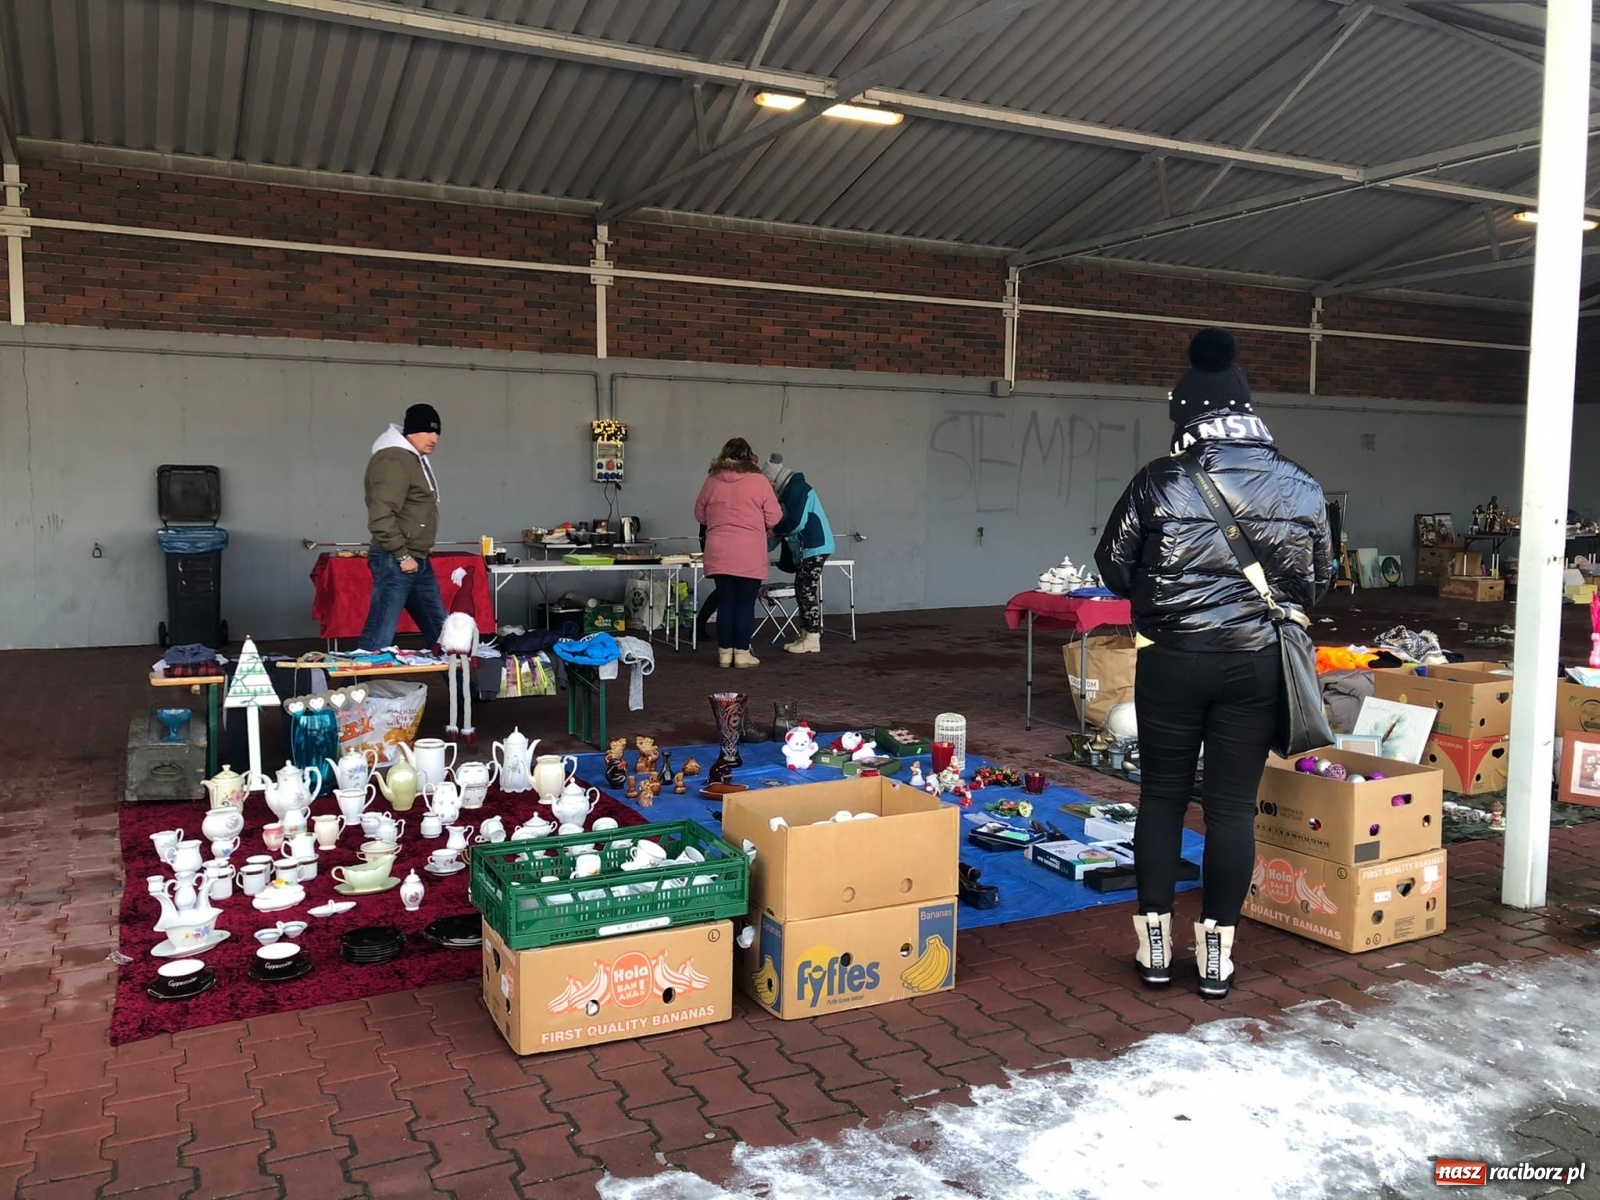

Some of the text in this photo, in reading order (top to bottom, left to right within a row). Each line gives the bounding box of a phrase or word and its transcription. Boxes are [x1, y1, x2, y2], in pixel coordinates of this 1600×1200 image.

[1268, 868, 1292, 883] Hola
[1363, 869, 1383, 880] FIRST
[1384, 863, 1413, 876] QUALITY
[920, 909, 953, 921] Bananas
[1251, 905, 1290, 923] QUALITY
[1292, 916, 1342, 940] BANANAS
[613, 964, 649, 983] Hola
[617, 981, 637, 993] BAN
[541, 1005, 716, 1044] FIRST QUALITY BANANAS
